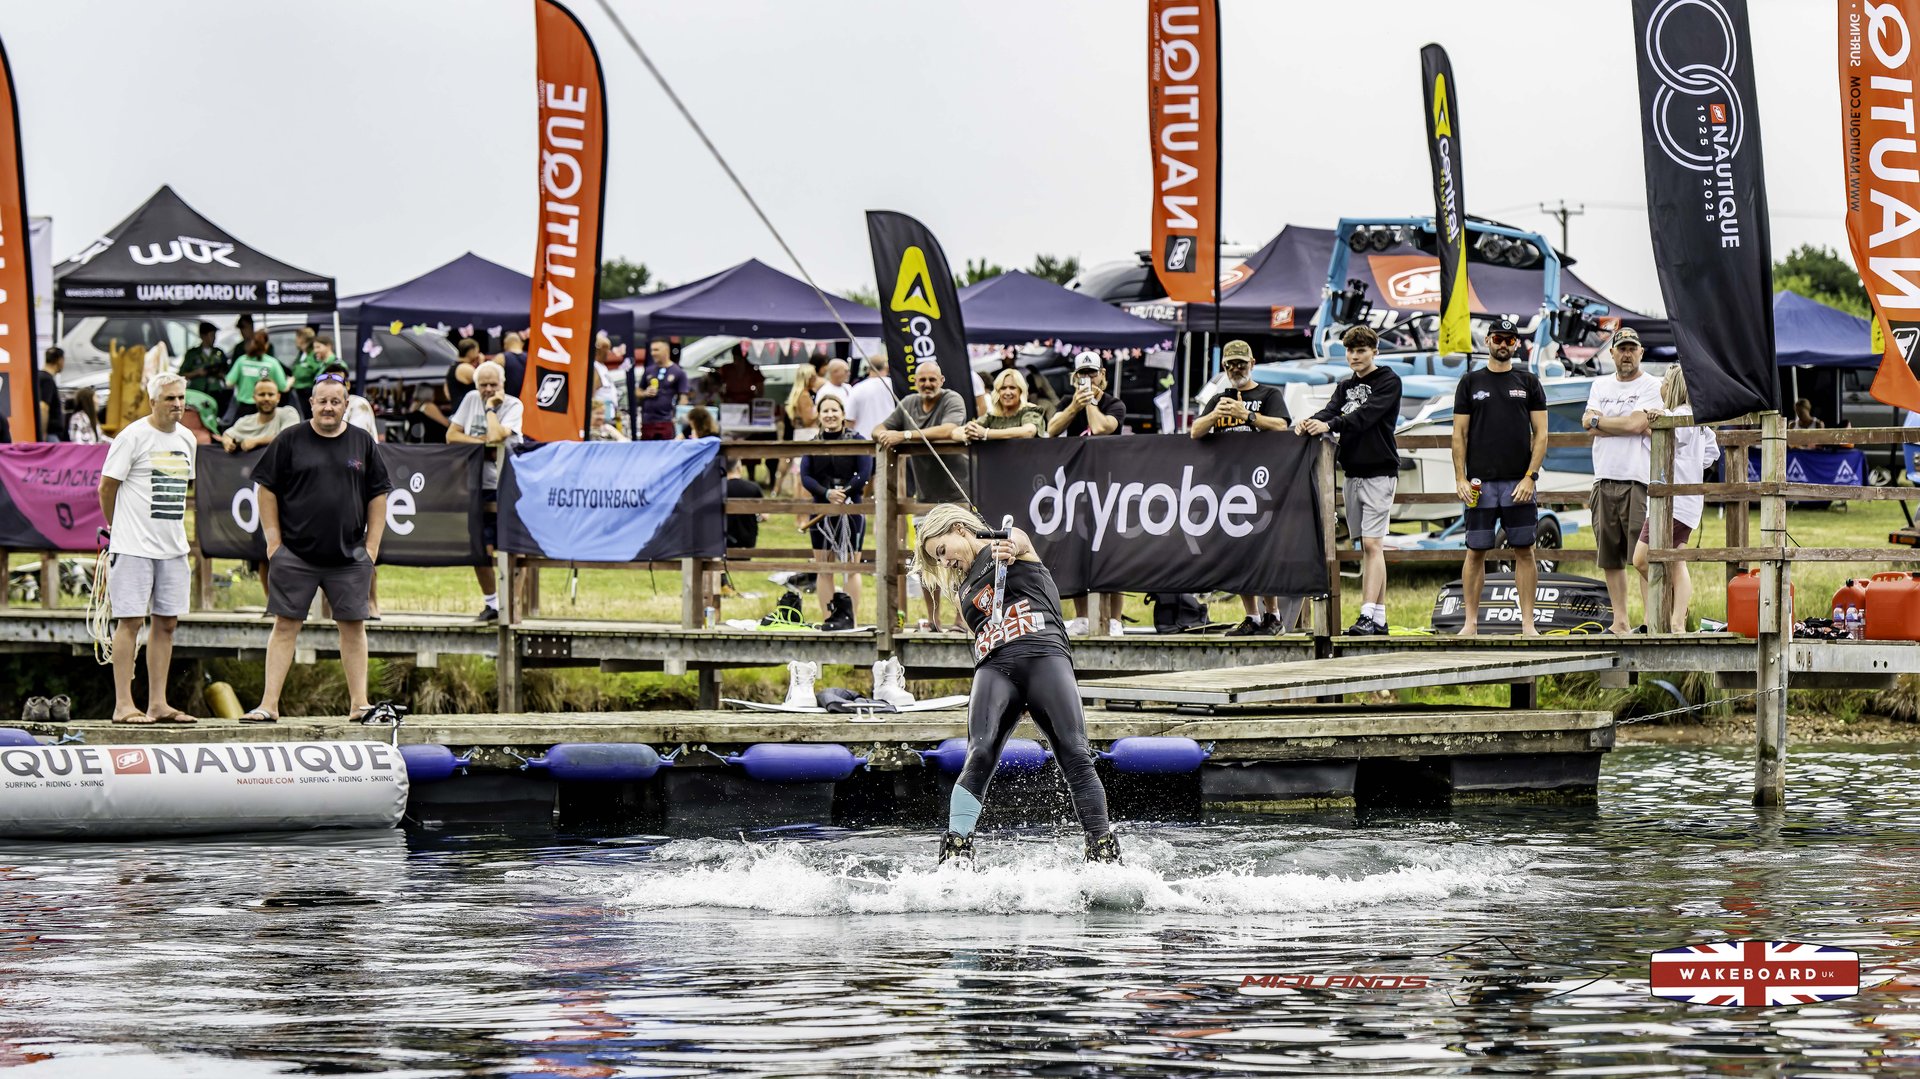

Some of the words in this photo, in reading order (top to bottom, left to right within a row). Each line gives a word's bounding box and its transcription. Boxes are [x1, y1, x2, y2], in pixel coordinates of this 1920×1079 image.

[1696, 105, 1709, 146] 1925
[1712, 125, 1740, 248] NAUTIQUE
[1703, 179, 1715, 222] 2025
[136, 284, 234, 301] WAKEBOARD
[235, 284, 258, 301] UK
[1490, 587, 1560, 606] LIQID
[151, 745, 392, 775] NAUTIQUE
[5, 781, 37, 789] SURFING
[45, 780, 72, 788] RIDING
[80, 779, 105, 787] SKIING
[236, 777, 295, 785] NAUTIQUE.COM
[299, 776, 330, 784] SURFING
[337, 775, 363, 783] RIDING
[370, 774, 394, 782] SKIING
